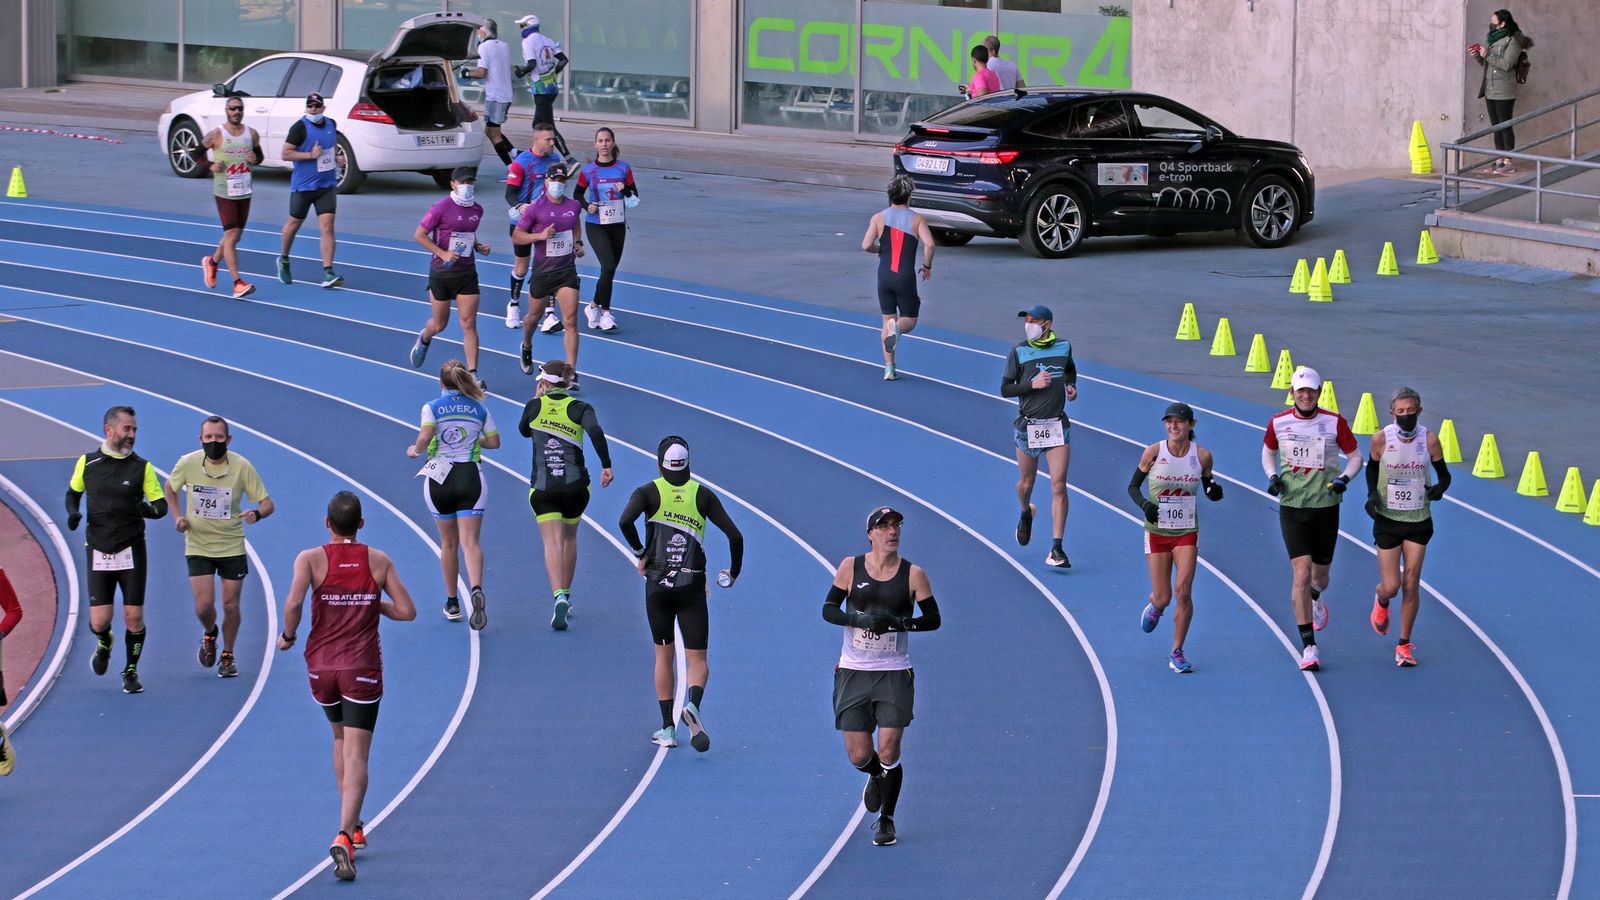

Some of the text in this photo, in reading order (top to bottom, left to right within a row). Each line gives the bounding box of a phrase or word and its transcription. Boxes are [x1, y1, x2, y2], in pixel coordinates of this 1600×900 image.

[1159, 162, 1233, 174] Q4 Sportback
[1159, 173, 1193, 182] e-tron
[604, 208, 616, 217] 457
[552, 241, 565, 249] 789
[438, 404, 478, 416] OLVERA
[1034, 429, 1050, 439] 846
[1293, 447, 1309, 457] 611
[1395, 490, 1412, 501] 592
[200, 498, 217, 509] 784
[663, 510, 673, 518] LA
[1167, 509, 1184, 519] 106
[341, 593, 377, 601] ATLETISMO
